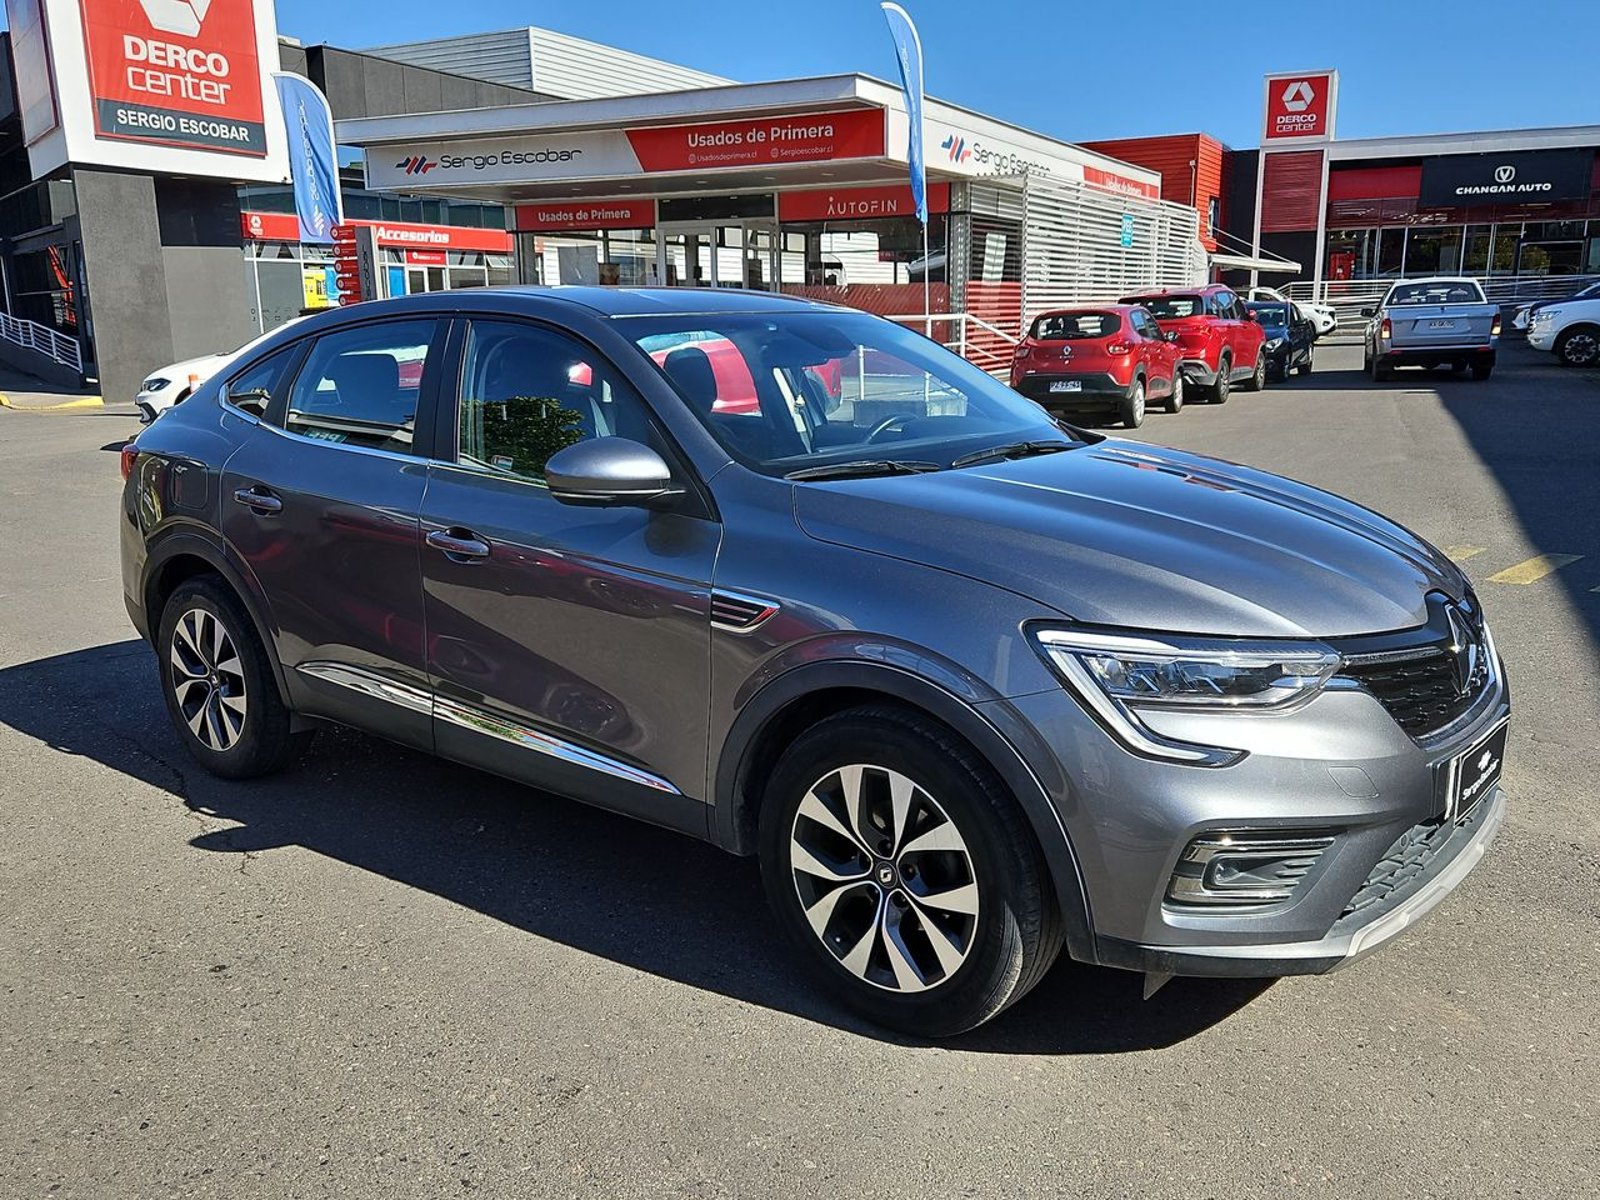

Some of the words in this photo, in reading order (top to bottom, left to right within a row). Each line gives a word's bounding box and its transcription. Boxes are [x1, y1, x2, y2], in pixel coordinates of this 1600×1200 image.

[123, 35, 230, 77] DERCO
[126, 66, 231, 105] center
[117, 109, 176, 131] SERGIO
[179, 118, 250, 142] ESCOBAR
[1276, 122, 1317, 132] center
[1277, 114, 1317, 124] DERCO
[688, 130, 743, 147] Usados
[746, 128, 766, 143] de
[770, 124, 834, 141] Primera
[501, 148, 583, 165] Escobar
[1456, 184, 1516, 195] CHANGAN
[1517, 183, 1552, 192] AUTO
[827, 196, 897, 216] AUTOFIN
[538, 211, 574, 222] Usados
[576, 210, 589, 220] de
[591, 209, 631, 219] Primera
[376, 226, 450, 244] Accesorios
